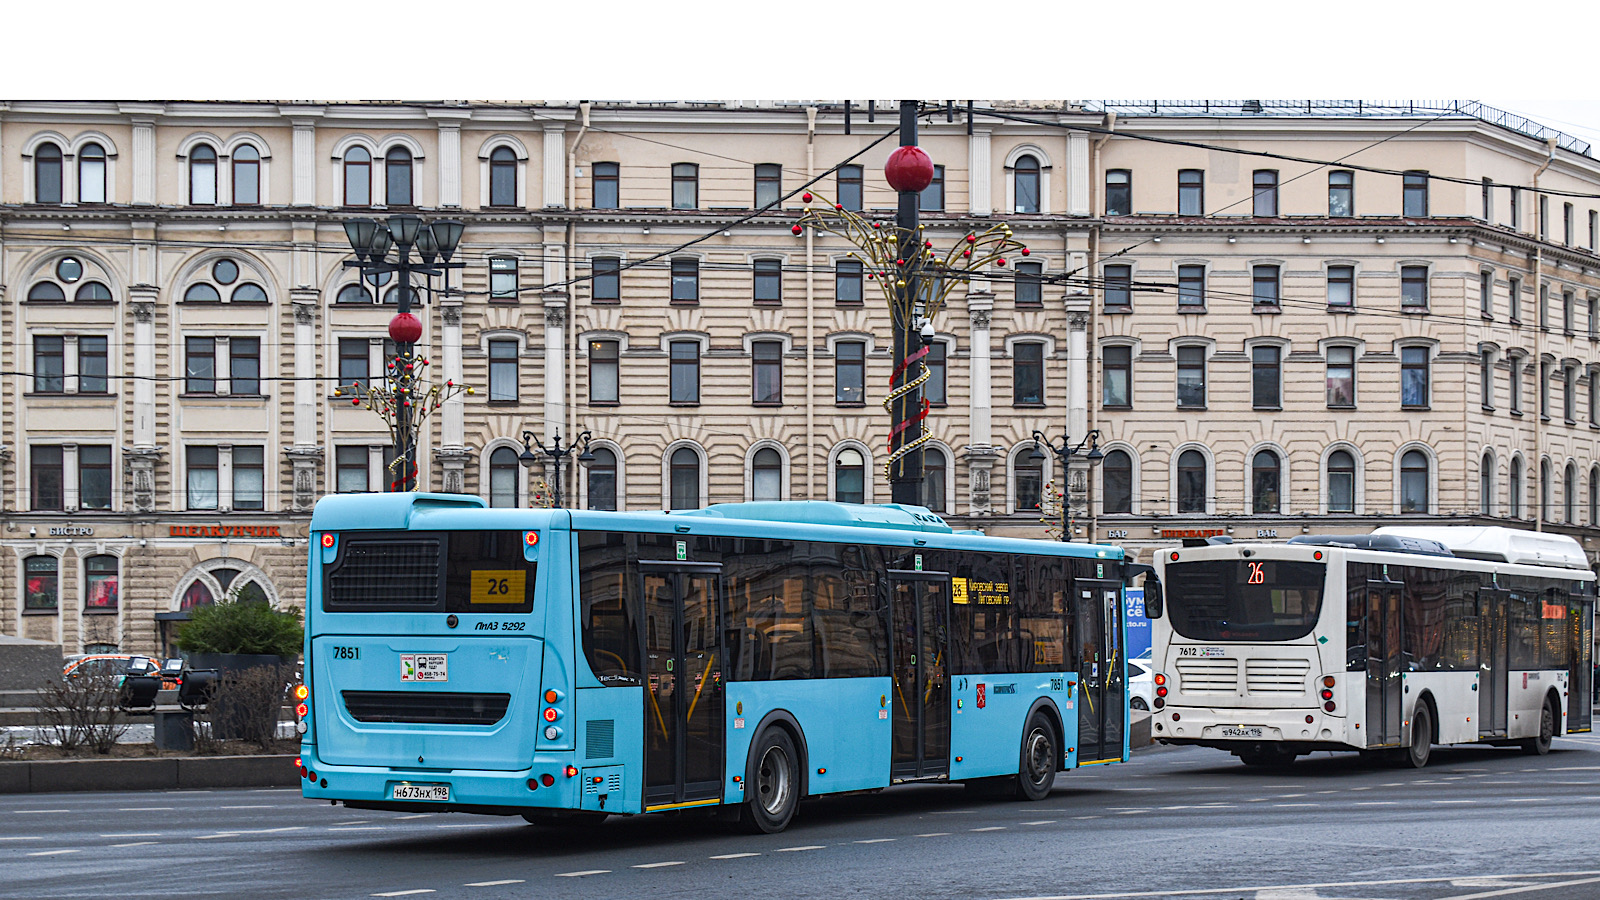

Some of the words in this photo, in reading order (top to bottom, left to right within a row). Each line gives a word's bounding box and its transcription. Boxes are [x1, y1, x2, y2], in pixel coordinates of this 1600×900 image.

[49, 527, 94, 536] БИСТРО
[169, 525, 281, 537] ЩЕЛКУНЧИК
[1107, 530, 1128, 538] БАР
[1161, 529, 1224, 538] ПИВОВАРНЯ
[1257, 529, 1277, 538] BAR
[1247, 561, 1264, 584] 26
[487, 578, 509, 595] 26
[953, 584, 962, 597] 26
[501, 621, 526, 631] 5292
[333, 646, 359, 660] 7851
[1179, 647, 1197, 656] 7612
[1050, 678, 1064, 691] 7851
[396, 786, 431, 798] Н673НХ
[432, 787, 448, 796] 198
